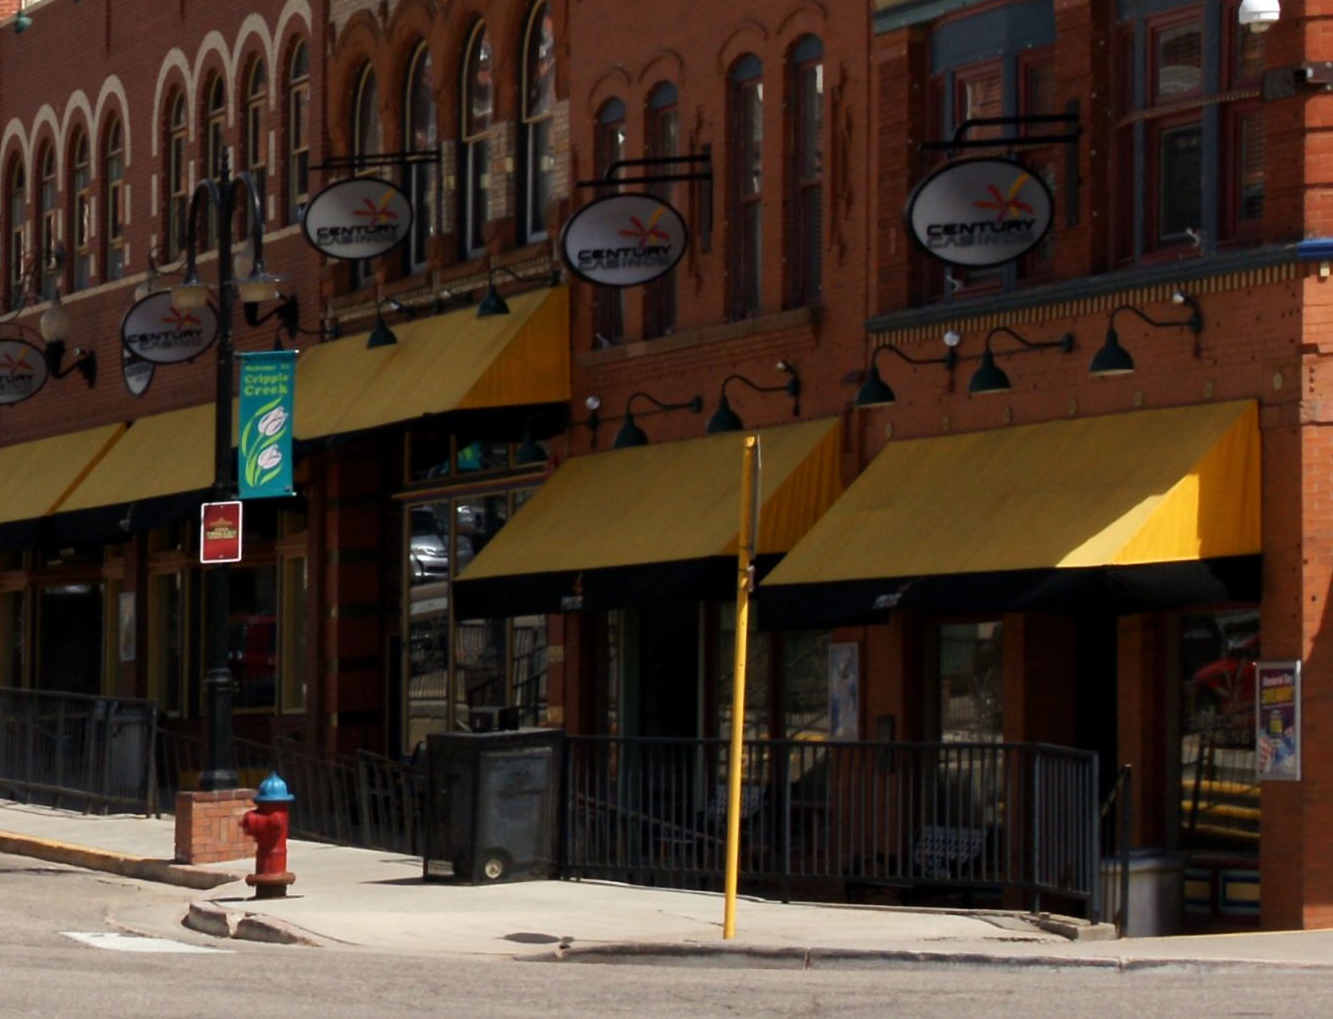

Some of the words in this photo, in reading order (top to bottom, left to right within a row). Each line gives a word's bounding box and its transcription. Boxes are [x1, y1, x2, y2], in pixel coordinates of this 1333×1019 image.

[317, 224, 398, 237] CENTURY
[927, 219, 1035, 236] CENTURY
[578, 245, 672, 260] CENTURY
[127, 329, 203, 343] CENTURY
[244, 373, 289, 385] Cripple
[244, 383, 288, 396] Creek
